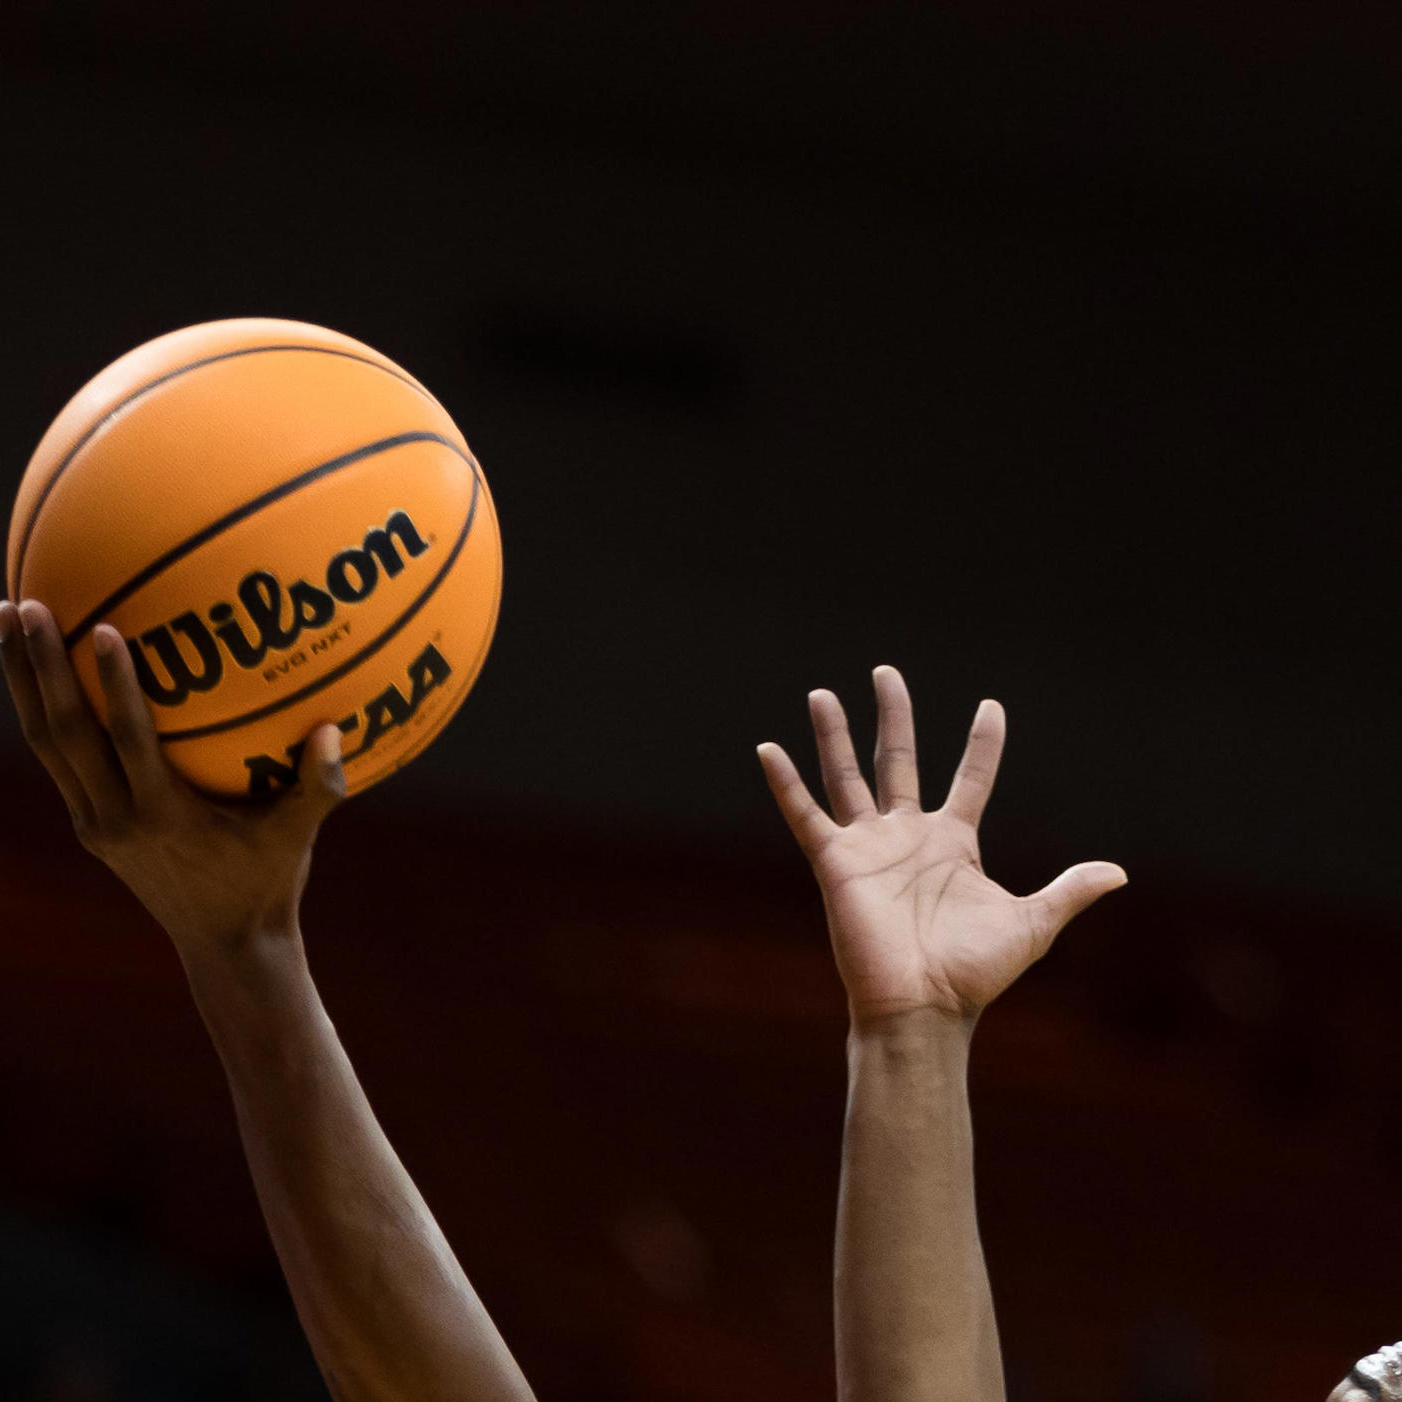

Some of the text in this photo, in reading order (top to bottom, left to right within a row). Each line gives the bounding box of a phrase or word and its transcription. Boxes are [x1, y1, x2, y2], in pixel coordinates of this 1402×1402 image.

[128, 510, 429, 706] Wilson
[262, 621, 351, 683] EVO NXT
